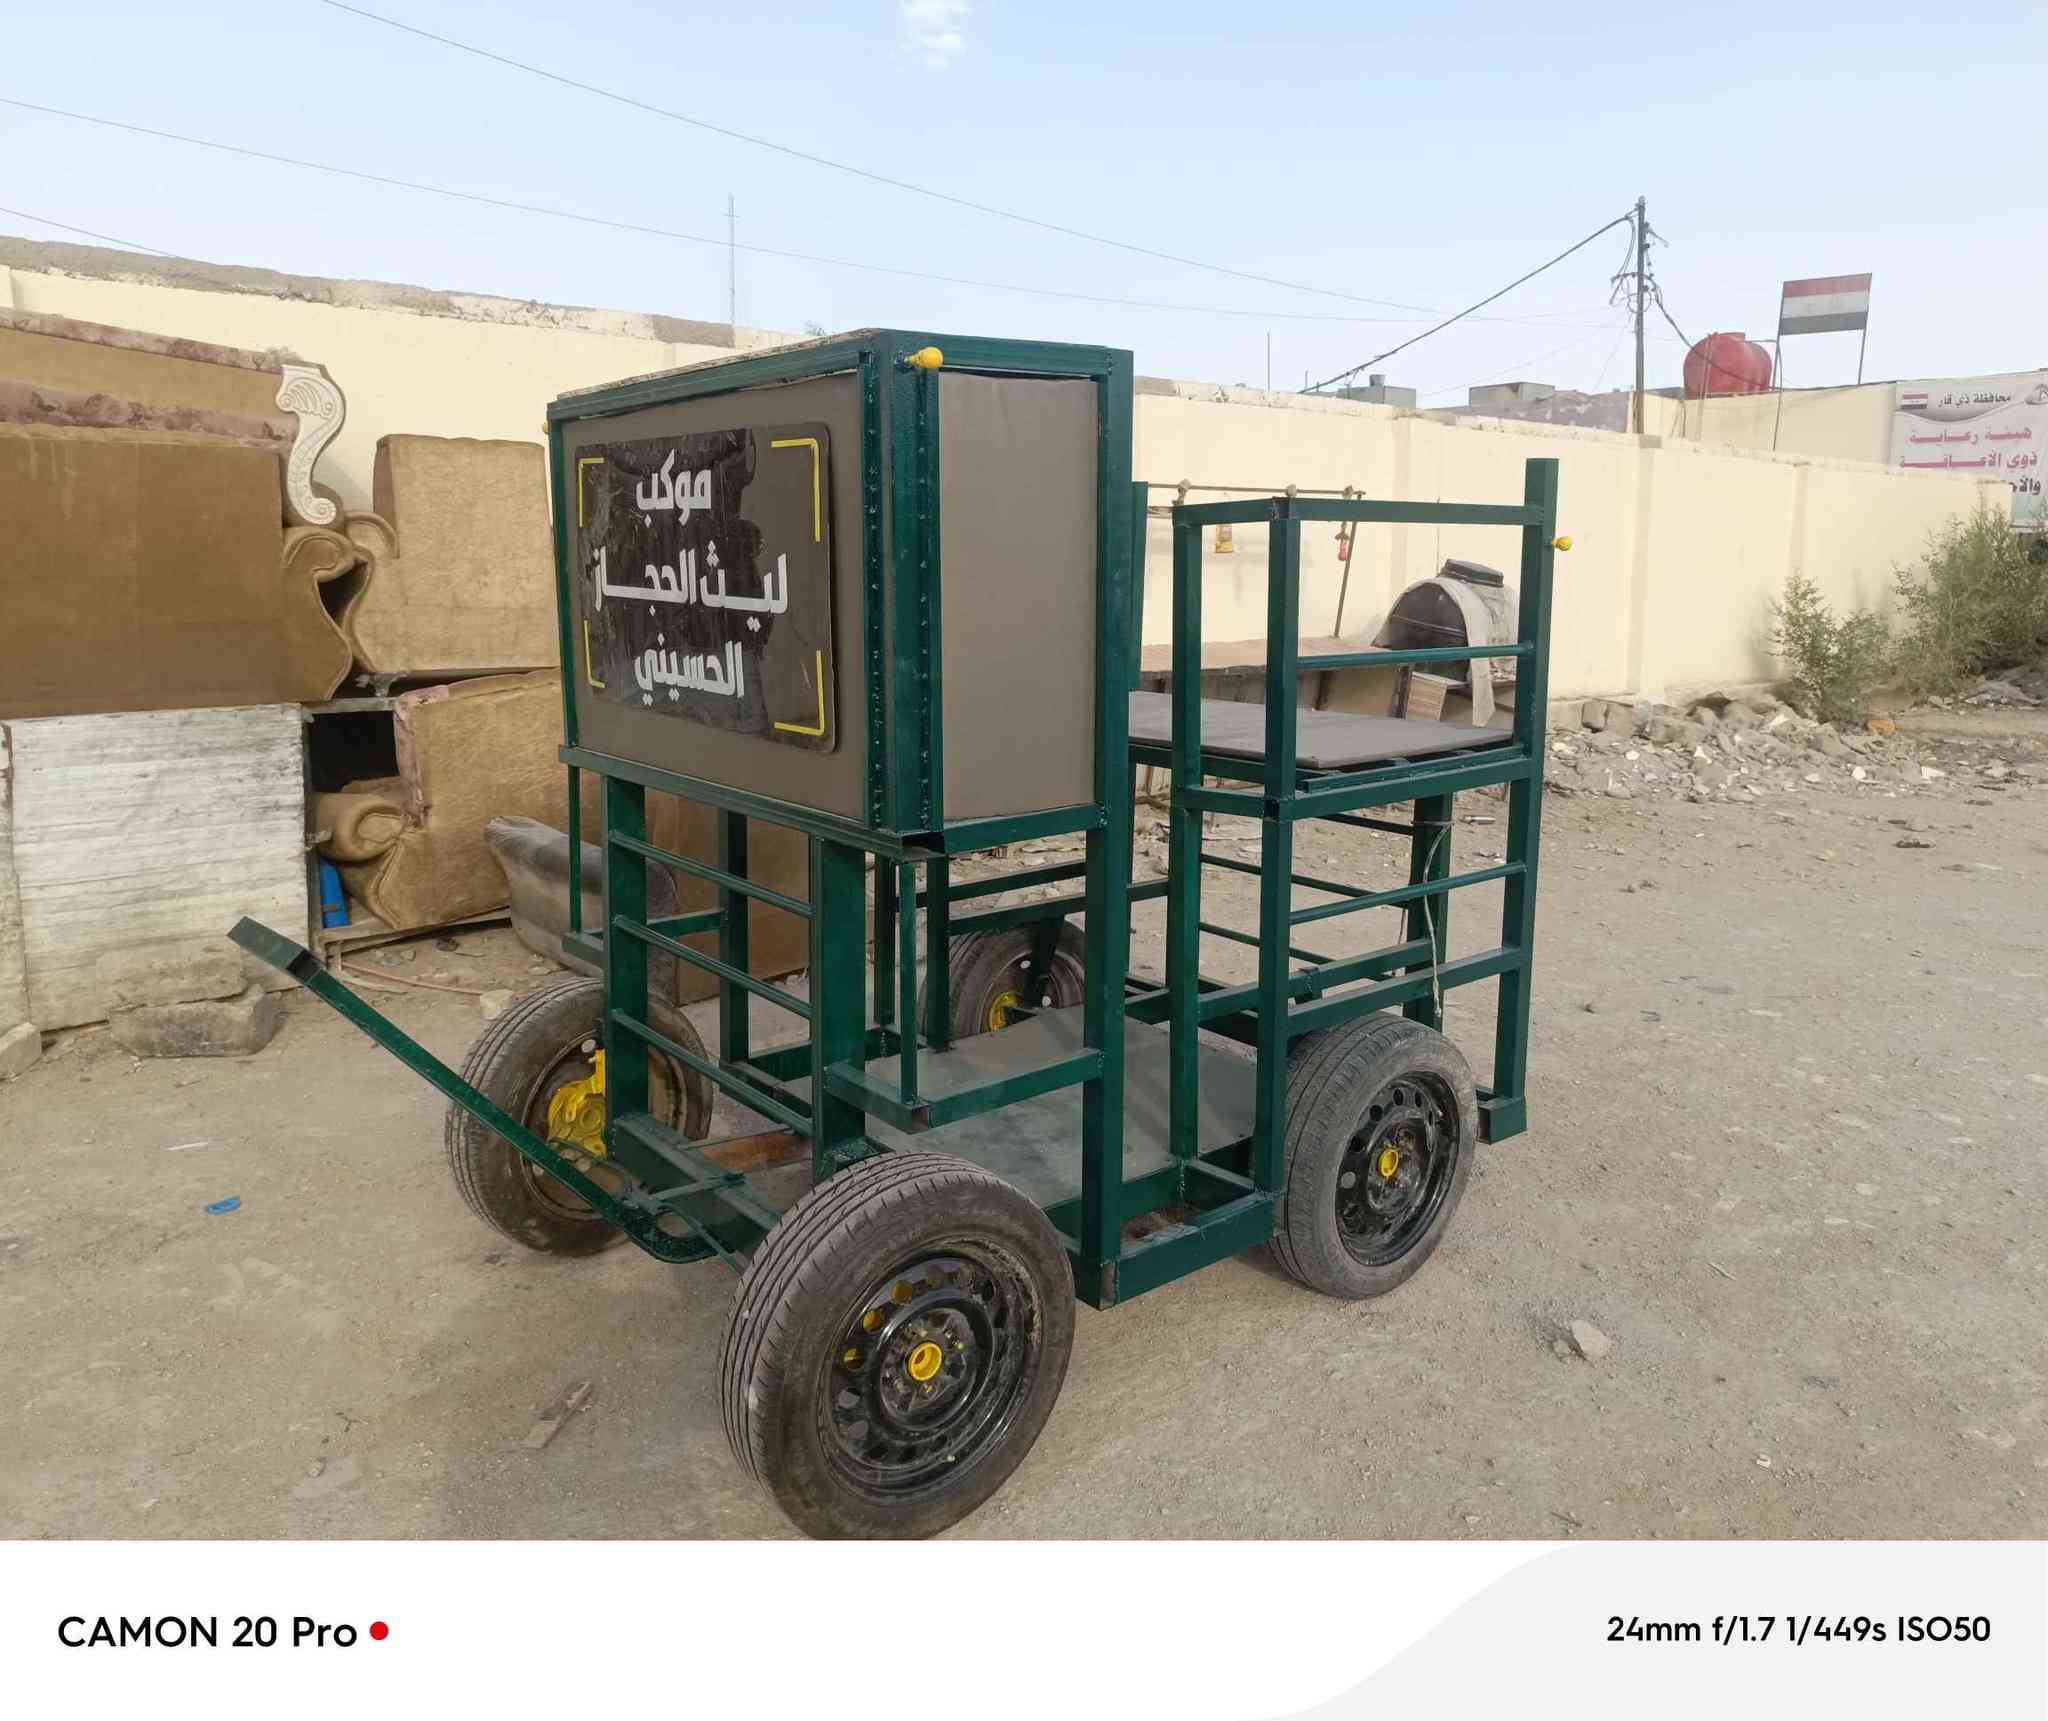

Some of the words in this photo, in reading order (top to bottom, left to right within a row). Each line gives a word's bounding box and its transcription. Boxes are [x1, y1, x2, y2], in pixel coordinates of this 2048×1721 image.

[1938, 393, 1952, 408] قار
[1955, 395, 1970, 408] ذي
[1973, 393, 2011, 404] محافظة
[636, 449, 712, 528] موكب
[593, 546, 697, 616] الحجاز
[634, 632, 745, 707] الحسيني
